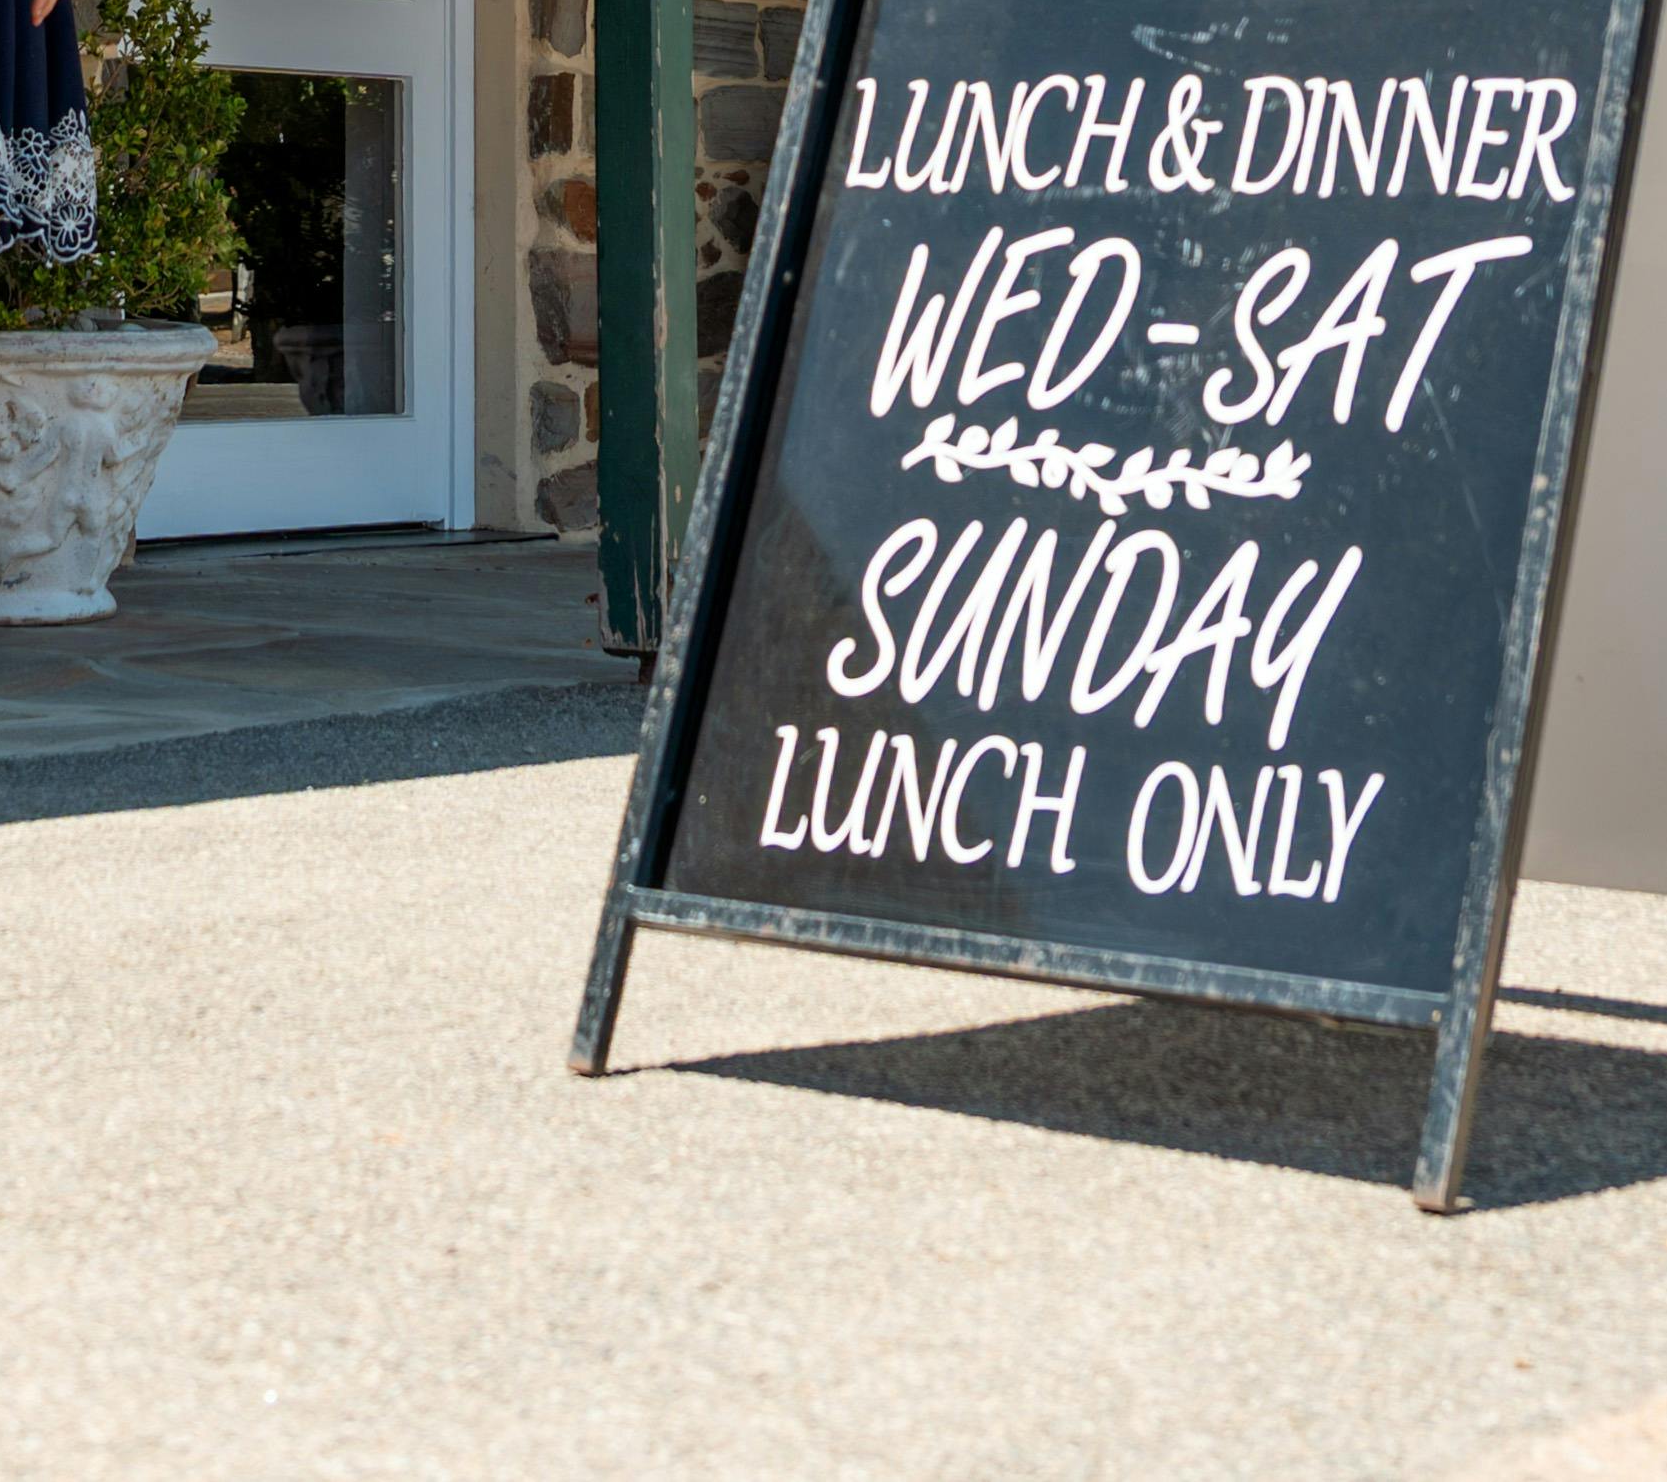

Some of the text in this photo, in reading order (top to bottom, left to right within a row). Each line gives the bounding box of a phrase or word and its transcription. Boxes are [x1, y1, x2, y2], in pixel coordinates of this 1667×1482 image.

[844, 73, 1578, 203] LUNCH & DINNER
[826, 515, 1364, 752] SUNDAY
[759, 723, 1386, 904] LUNCH ONLY
